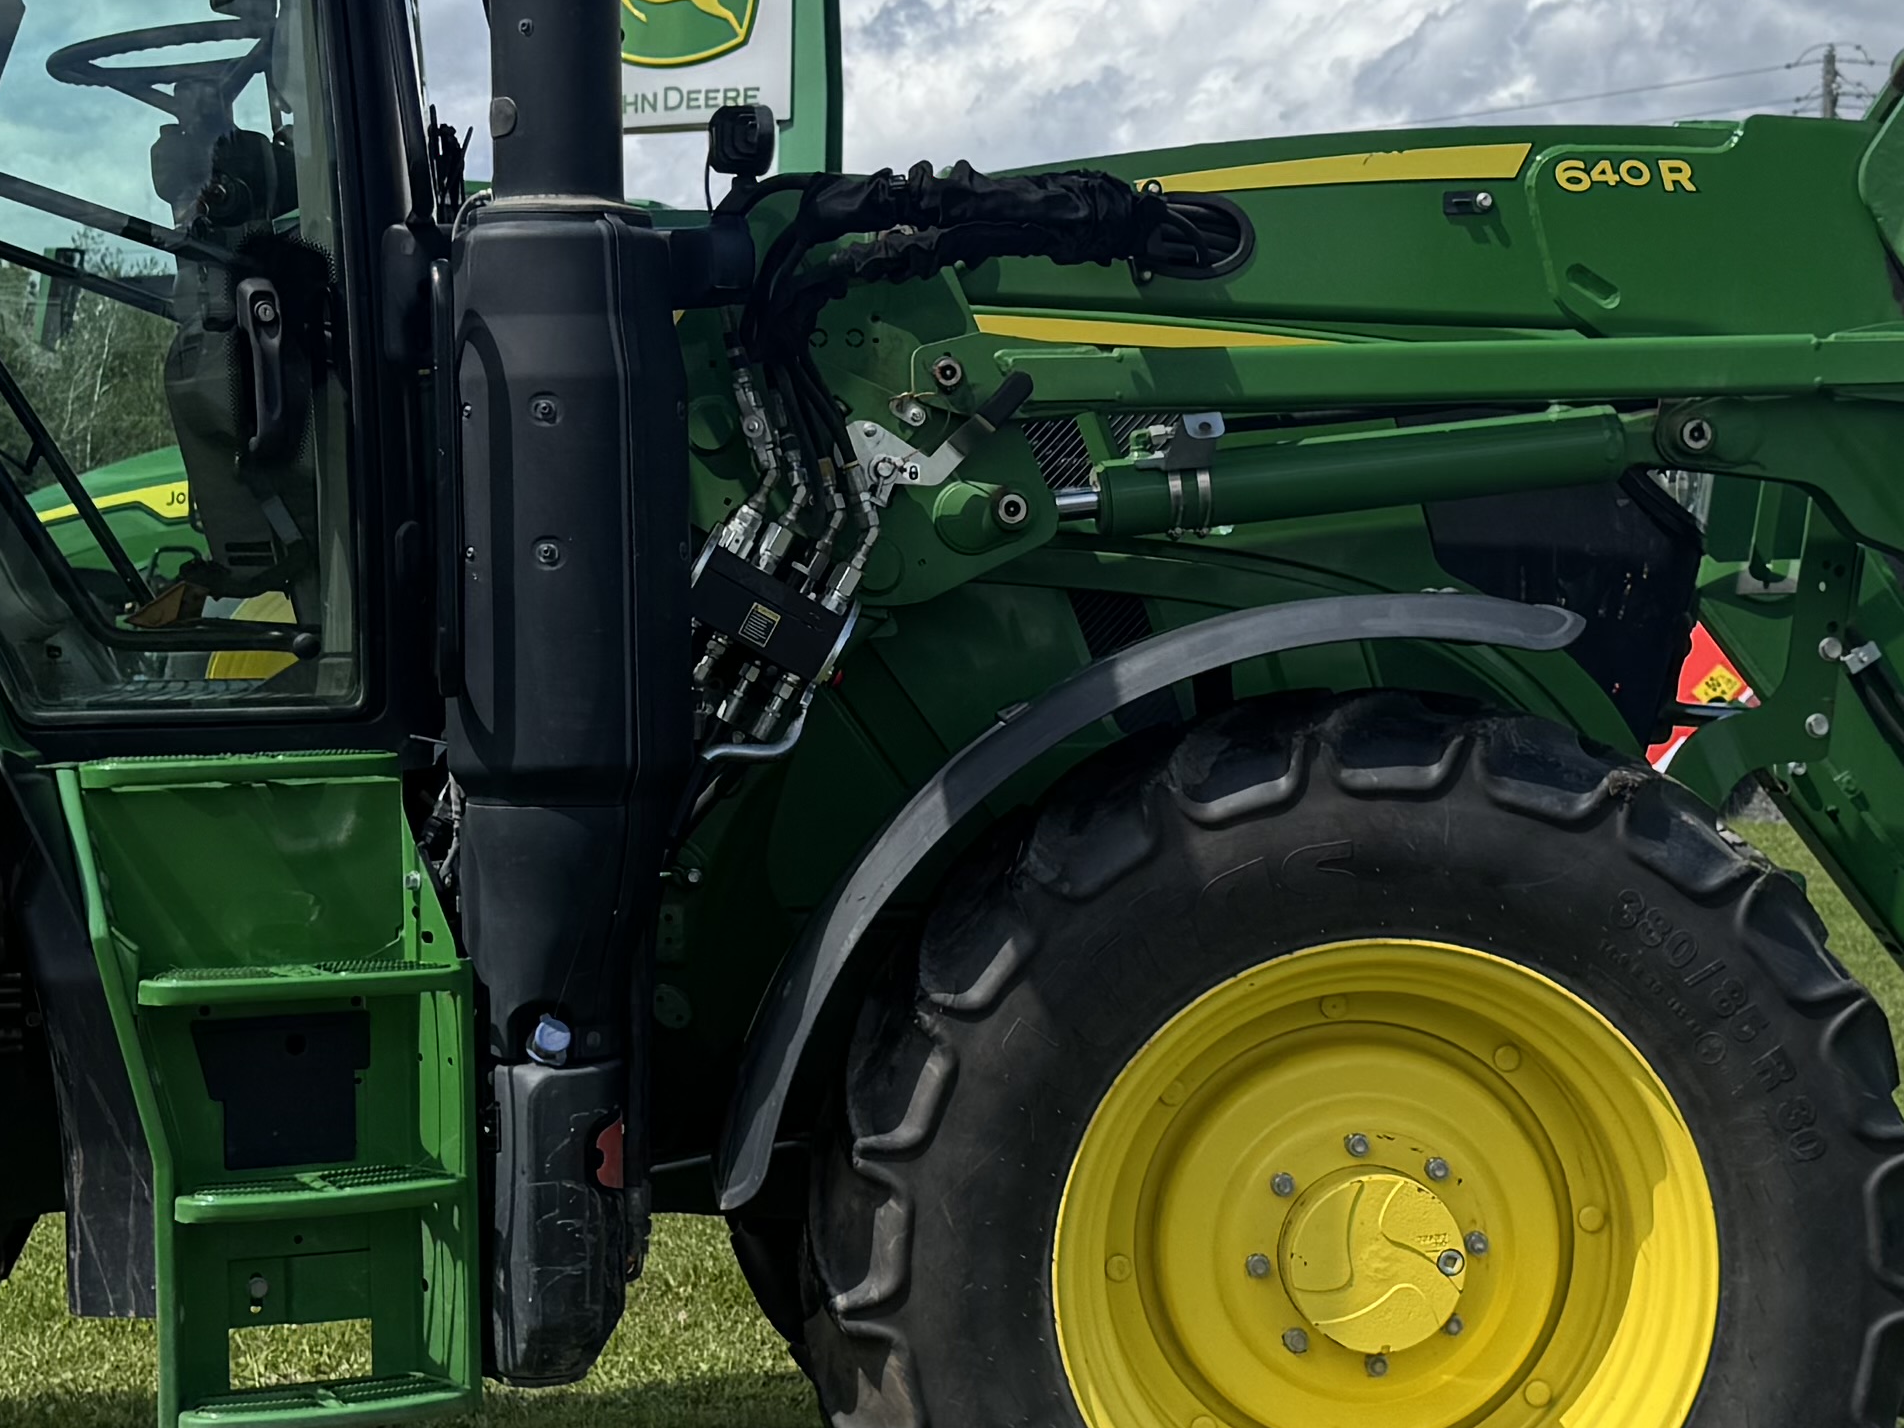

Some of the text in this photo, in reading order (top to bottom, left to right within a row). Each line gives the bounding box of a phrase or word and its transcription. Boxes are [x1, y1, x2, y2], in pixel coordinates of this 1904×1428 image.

[623, 86, 761, 114] HN DEERE
[1554, 158, 1698, 193] 640 R
[165, 490, 186, 507] JO
